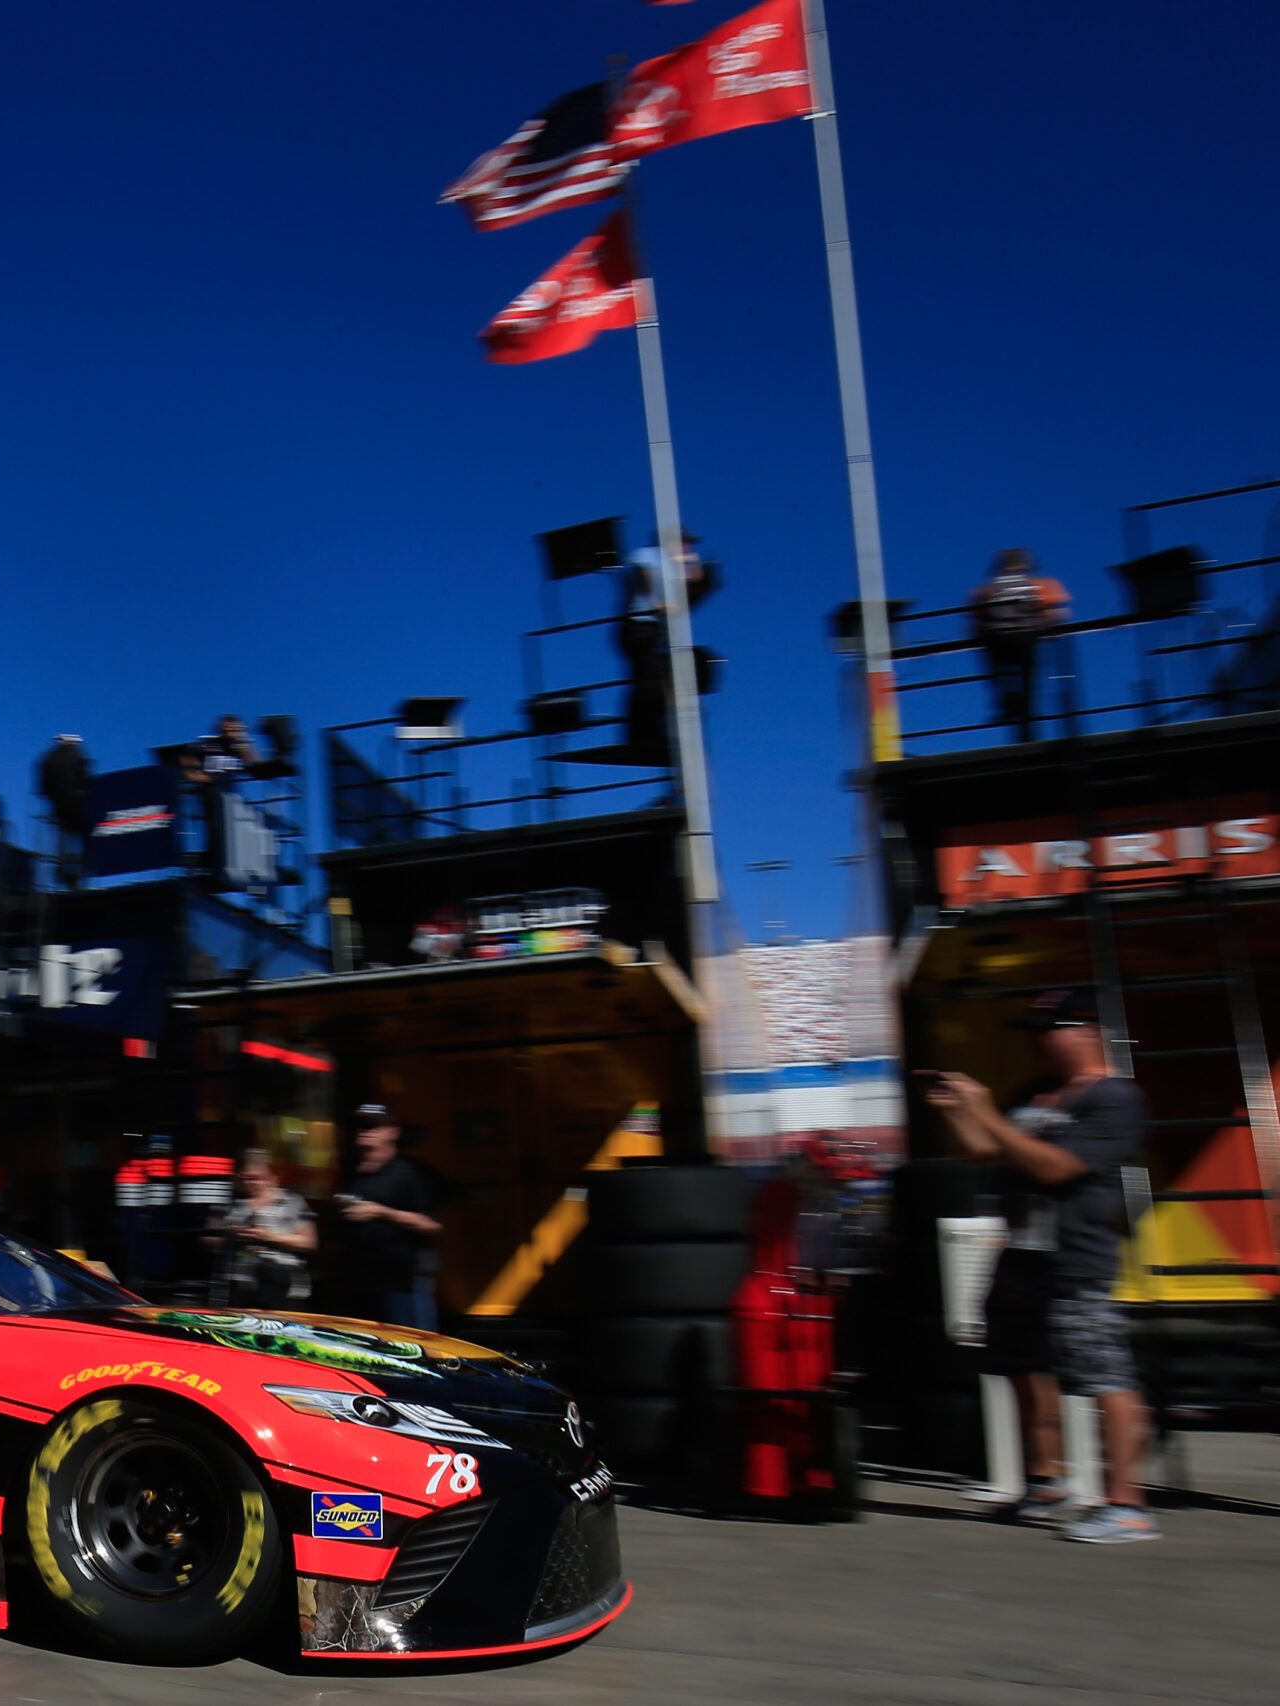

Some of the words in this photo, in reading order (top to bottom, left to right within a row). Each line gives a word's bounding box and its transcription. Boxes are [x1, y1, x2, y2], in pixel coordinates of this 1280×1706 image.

[955, 817, 1275, 882] ARRIS
[426, 1453, 477, 1495] 78
[318, 1510, 378, 1523] SUNOCO
